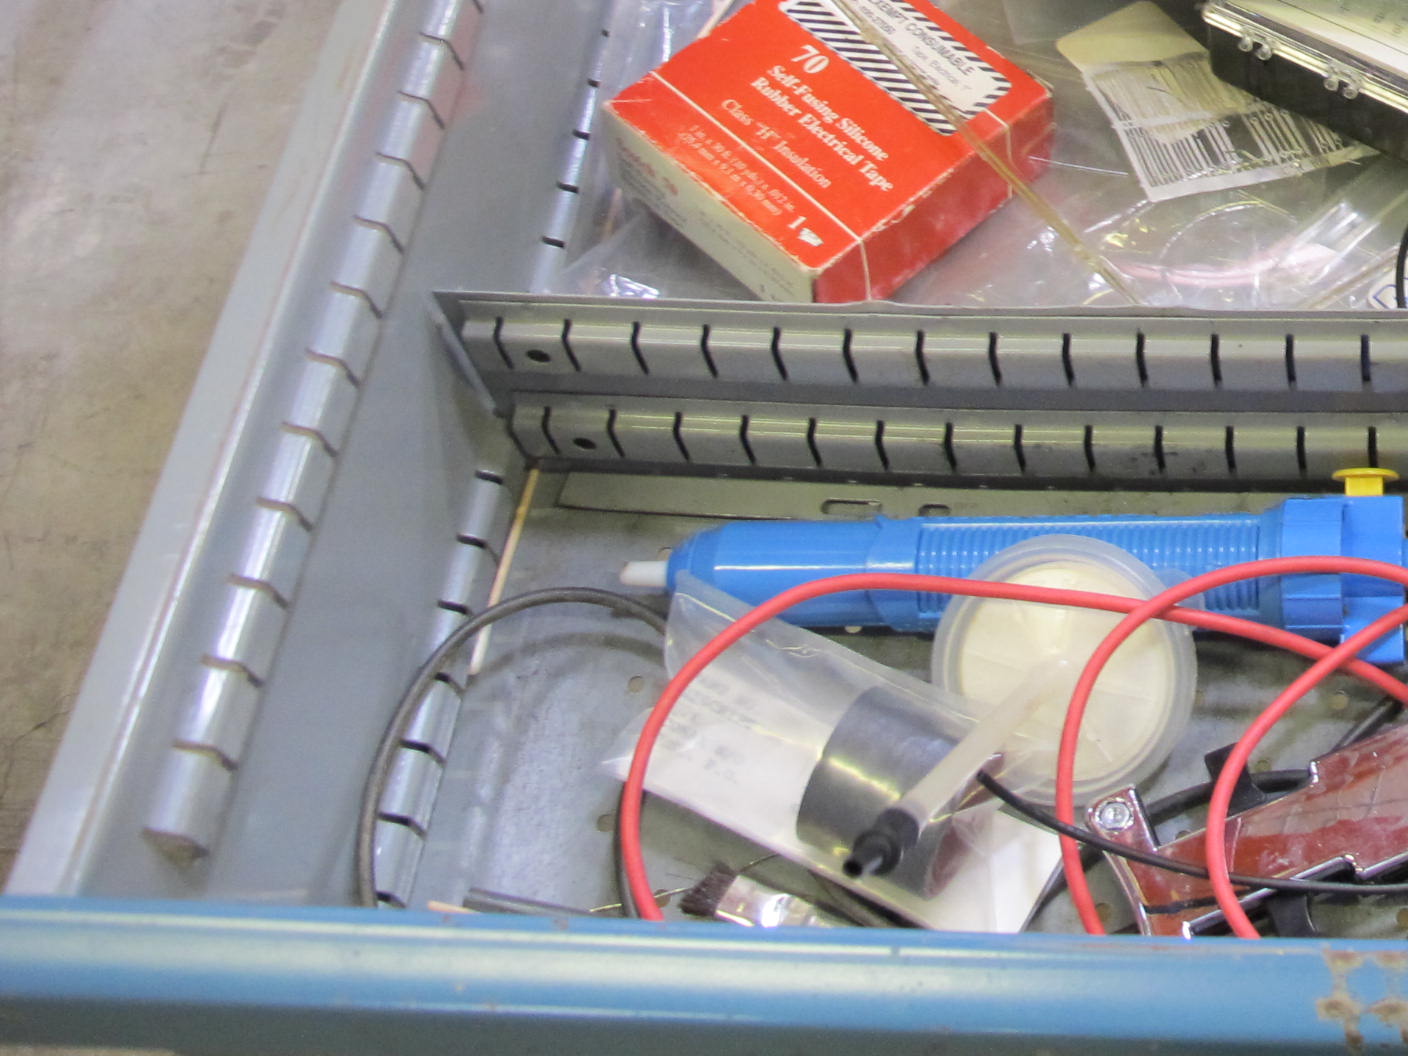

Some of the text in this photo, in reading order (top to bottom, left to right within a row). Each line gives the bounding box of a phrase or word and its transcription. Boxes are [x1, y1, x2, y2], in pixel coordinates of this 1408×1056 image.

[791, 44, 830, 74] 70
[905, 21, 976, 76] CONSUMABLE
[721, 99, 753, 126] Class
[773, 140, 832, 188] Insulation
[751, 77, 894, 192] Rubber Electrical Tape
[767, 65, 889, 161] Self-Fusing Silicone
